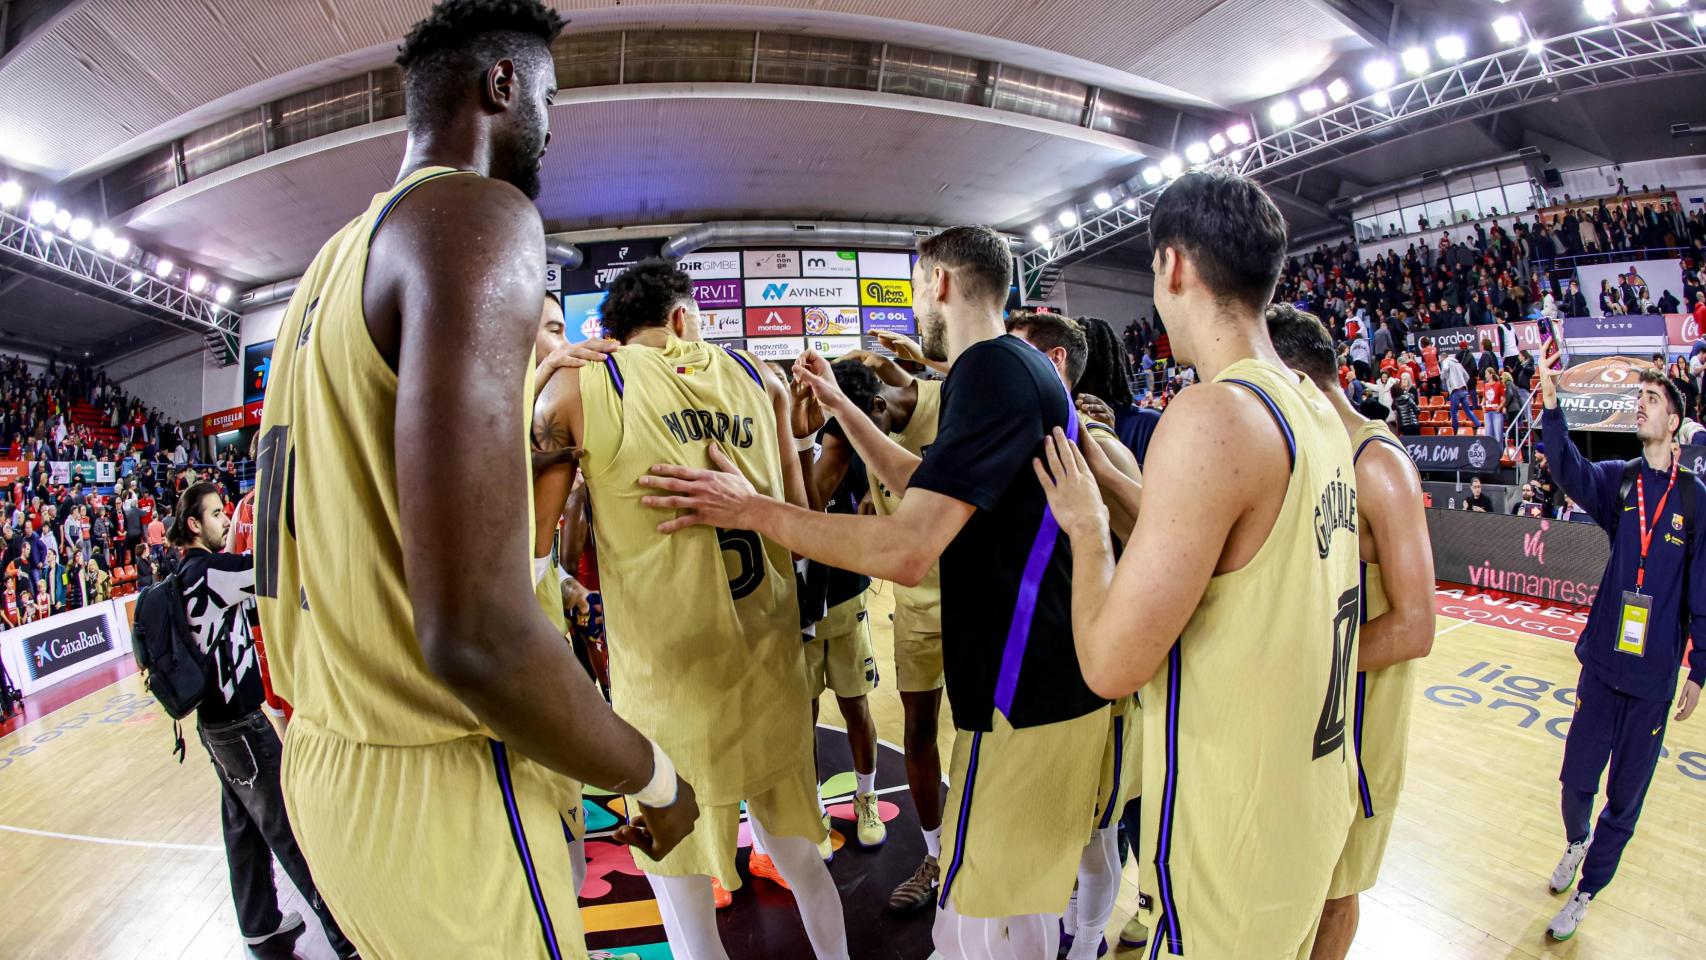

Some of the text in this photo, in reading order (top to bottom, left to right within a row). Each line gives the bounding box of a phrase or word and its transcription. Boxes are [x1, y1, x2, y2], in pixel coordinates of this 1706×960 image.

[788, 288, 843, 297] AVINENT
[887, 312, 907, 321] GOL
[213, 412, 243, 426] ESTRELLA
[1314, 466, 1358, 559] GONZÁLE
[1441, 606, 1580, 639] CONGO
[51, 626, 106, 659] CaixaBank
